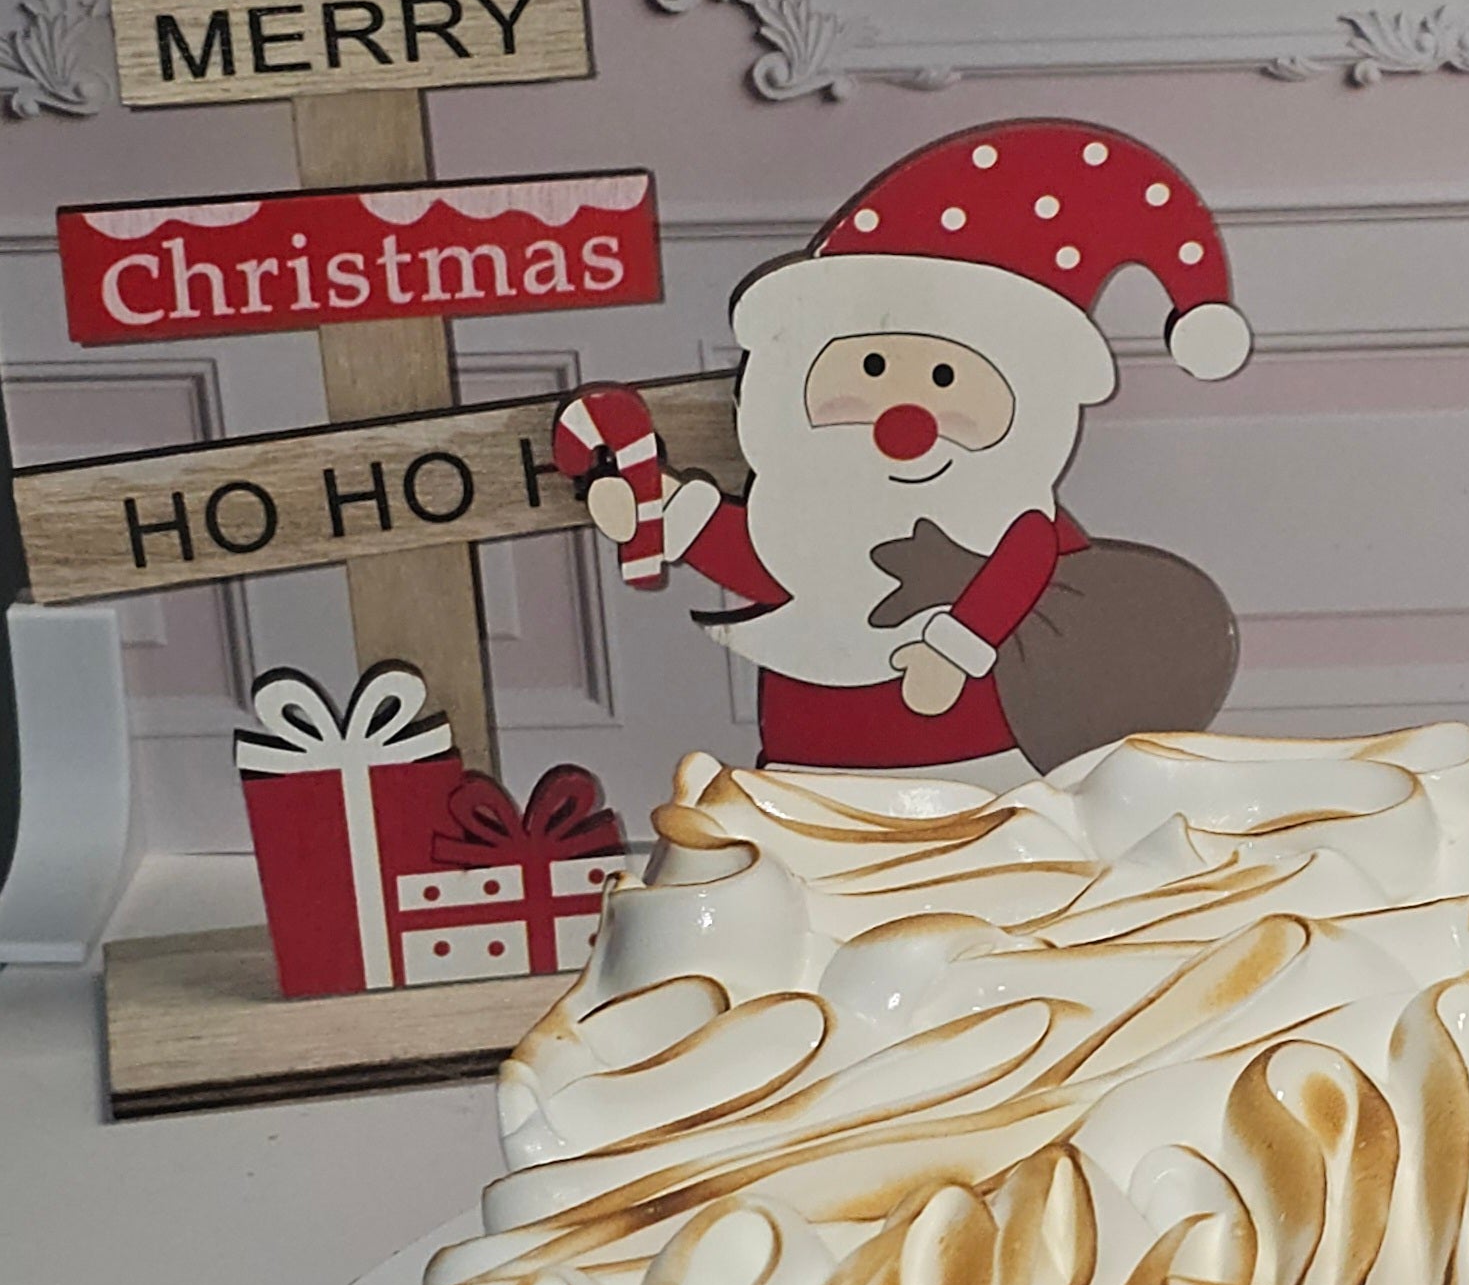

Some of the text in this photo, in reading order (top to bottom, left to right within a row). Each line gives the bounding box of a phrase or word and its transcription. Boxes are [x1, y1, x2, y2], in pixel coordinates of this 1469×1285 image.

[101, 232, 626, 326] Christmas
[123, 481, 278, 569] HO
[323, 451, 475, 538] HO
